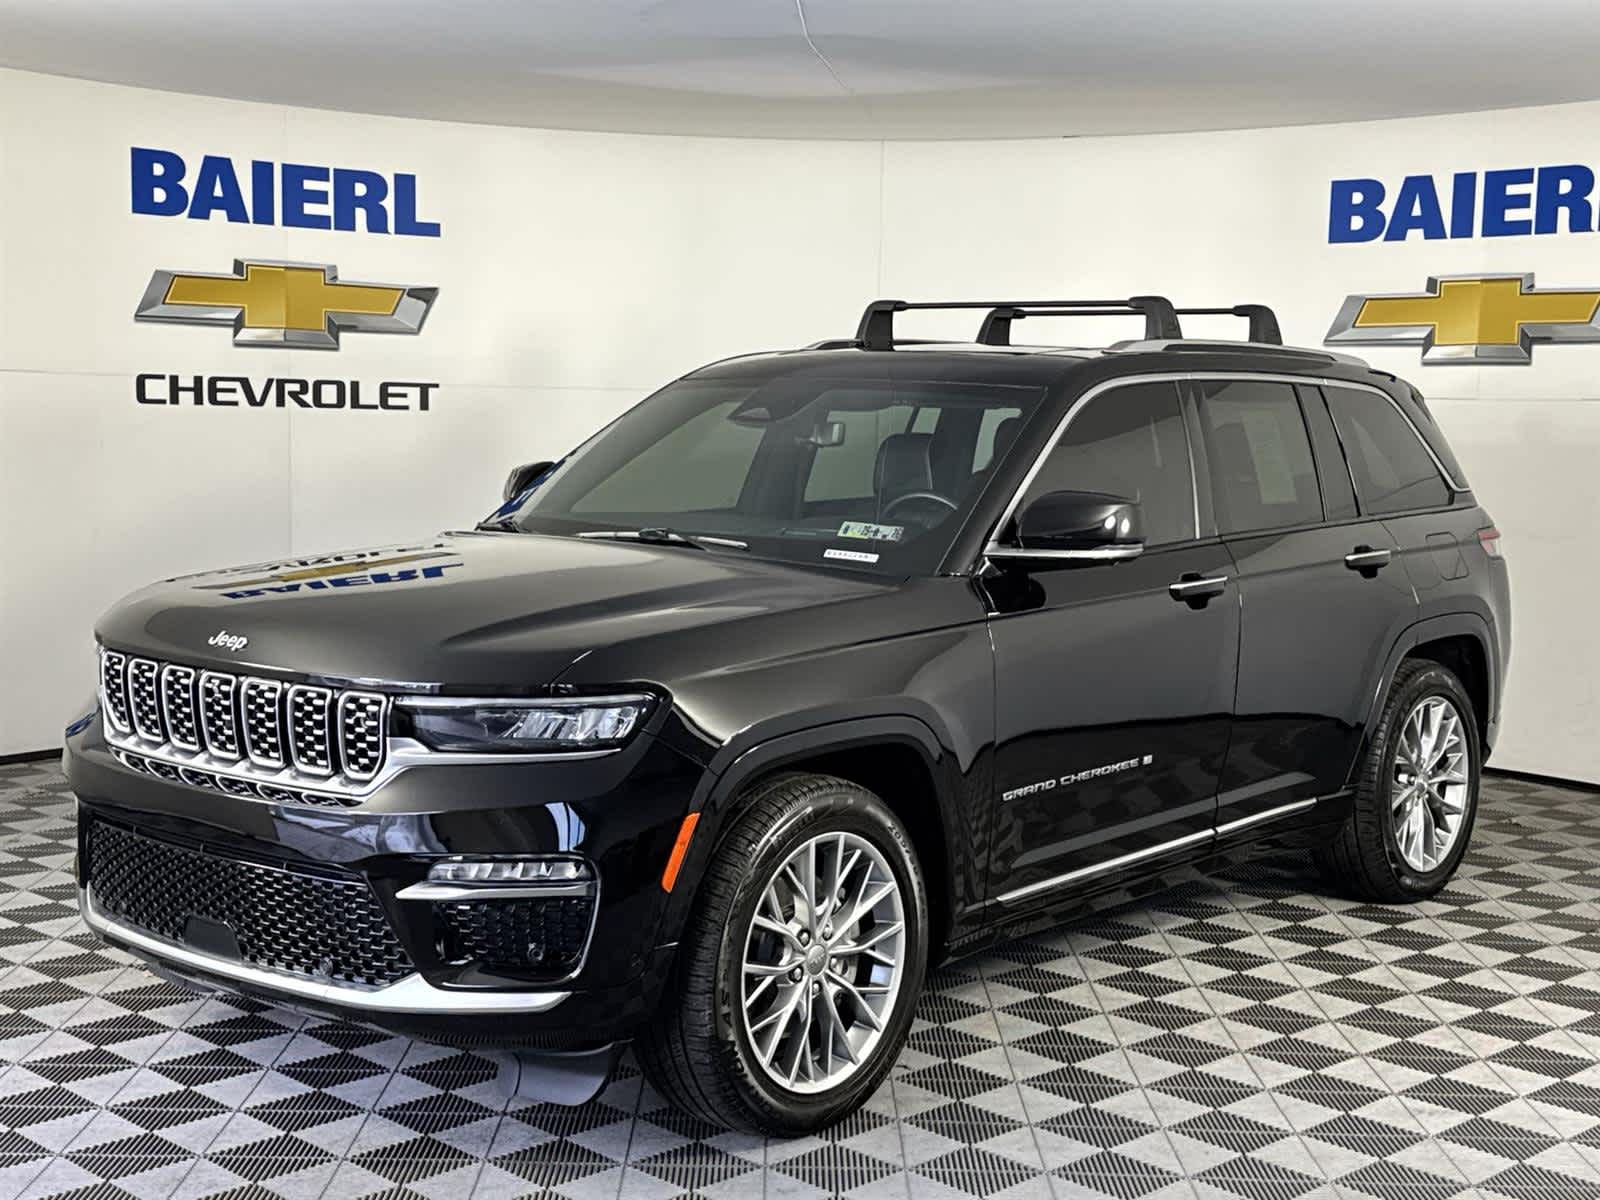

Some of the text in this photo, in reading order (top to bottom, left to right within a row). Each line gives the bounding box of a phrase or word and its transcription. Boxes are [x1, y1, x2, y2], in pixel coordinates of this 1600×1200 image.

[131, 147, 441, 238] BAIERL
[1328, 164, 1600, 244] BAIER
[136, 374, 440, 411] CHEVROLET
[208, 630, 248, 651] Jeep
[1002, 758, 1140, 802] GRAND CHEROKEE
